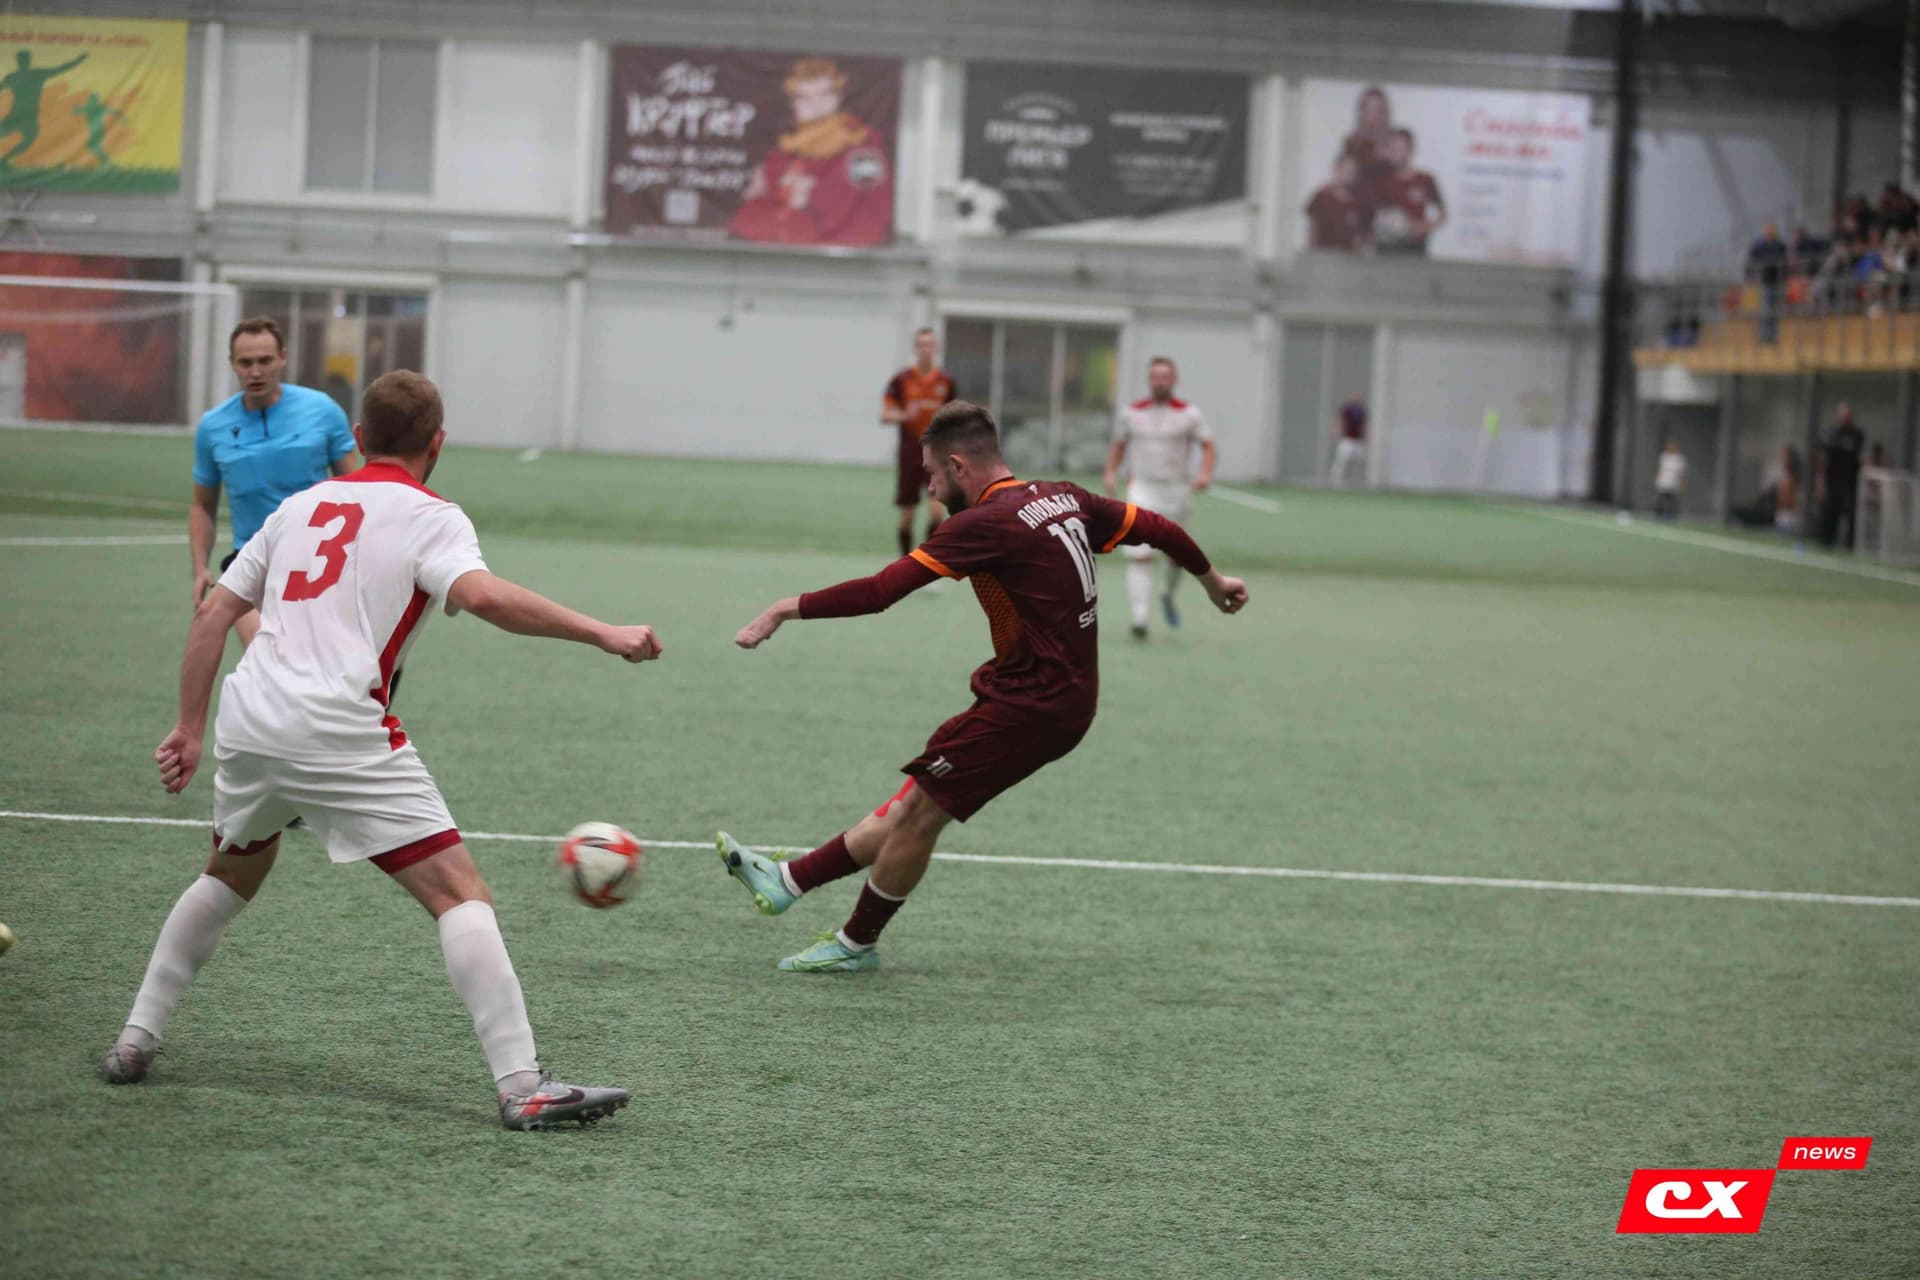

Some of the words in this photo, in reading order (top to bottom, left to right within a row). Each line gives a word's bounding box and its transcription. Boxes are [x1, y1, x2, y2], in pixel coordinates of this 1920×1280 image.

[282, 502, 365, 602] 3
[1047, 517, 1097, 603] 10
[926, 755, 953, 778] 10
